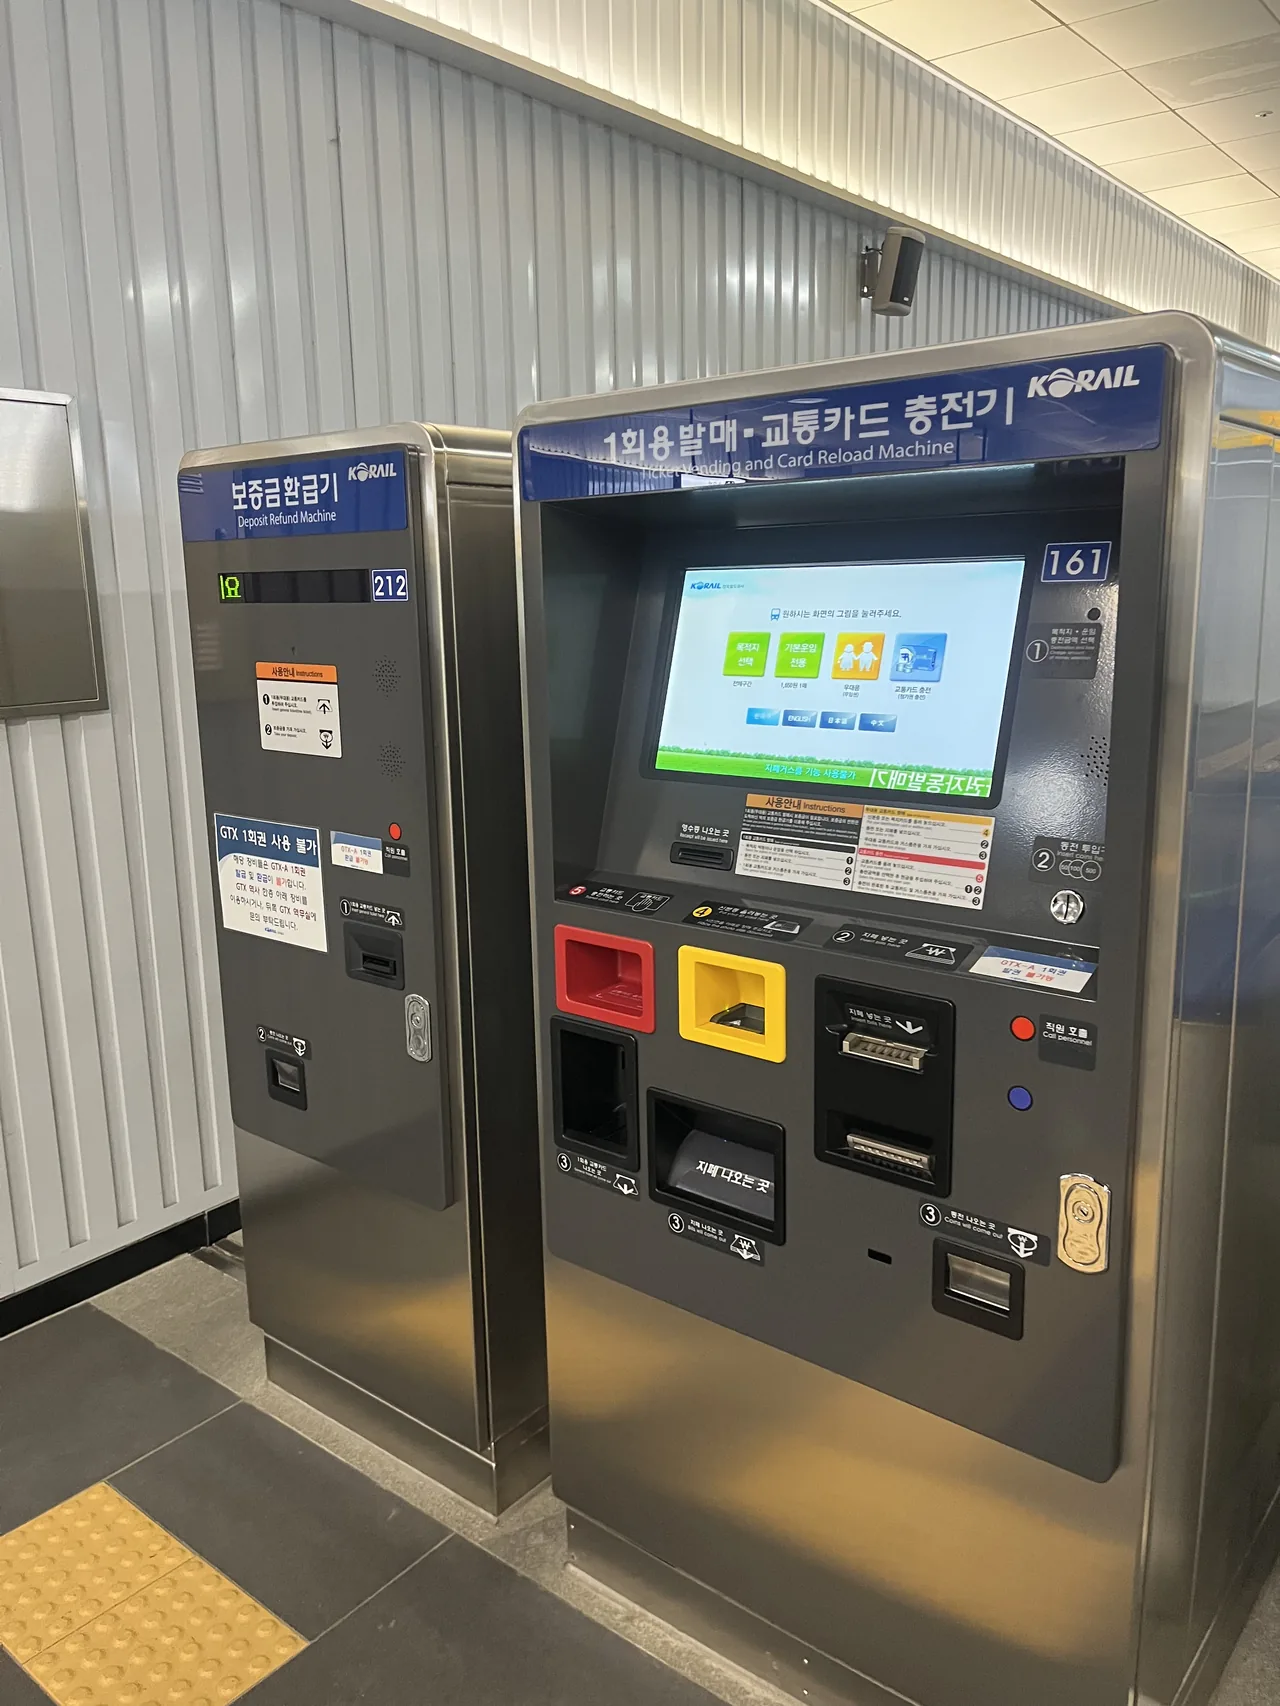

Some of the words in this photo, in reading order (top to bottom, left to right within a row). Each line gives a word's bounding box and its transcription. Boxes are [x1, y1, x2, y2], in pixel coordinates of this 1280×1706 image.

[1027, 364, 1140, 398] KORAIL
[904, 386, 1014, 436] 충전기
[682, 459, 741, 476] Vending
[744, 454, 773, 472] and
[777, 451, 813, 469] Card
[818, 446, 874, 465] Reload
[878, 440, 954, 460] Machine
[348, 462, 397, 482] KORAIL
[232, 472, 338, 511] 보증금환급기
[238, 515, 268, 530] Deposit
[270, 512, 298, 527] Refund
[300, 509, 336, 524] Machine
[1050, 548, 1101, 576] 161
[374, 575, 406, 597] 212
[690, 581, 721, 590] KORAIL
[782, 610, 811, 618] 원하시는
[812, 609, 834, 618] 화면의
[836, 609, 860, 618] 그림을
[861, 608, 902, 618] 눌러주세요.
[1082, 628, 1096, 636] 운임
[736, 642, 760, 652] 목적지
[1080, 636, 1095, 644] 선택
[784, 643, 817, 653] 기본운임
[738, 657, 754, 666] 선택
[790, 658, 807, 668] 전용
[272, 667, 295, 678] 사용안내
[296, 670, 323, 678] Instructions
[919, 686, 932, 694] 충전
[806, 767, 820, 778] 기능
[823, 768, 856, 780] 사용불가
[765, 796, 802, 810] 사용안내
[803, 803, 846, 813] Instructions
[702, 826, 721, 836] 나오는
[722, 829, 730, 837] 곳
[220, 825, 238, 840] GTX
[242, 829, 266, 847] 1회권
[271, 834, 291, 852] 사용
[296, 837, 317, 856] 불가
[1060, 841, 1078, 852] 동전
[236, 882, 247, 892] GTX
[279, 905, 291, 915] GTX
[694, 907, 711, 917] 4
[862, 932, 880, 940] 지폐
[880, 935, 897, 943] 넣는
[1000, 960, 1035, 971] GTX-A
[1042, 967, 1068, 976] 1회권
[849, 1008, 864, 1017] 지폐
[866, 1012, 882, 1022] 넣는
[883, 1016, 892, 1024] 곳
[1046, 1022, 1065, 1034] 직원
[1068, 1026, 1088, 1038] 호출
[1043, 1031, 1056, 1039] Call
[1058, 1034, 1092, 1046] personnel
[696, 1160, 718, 1178] 지폐
[720, 1168, 755, 1189] 나오는
[756, 1179, 771, 1194] 곳
[690, 1219, 701, 1228] 지폐
[701, 1223, 717, 1234] 나오는
[717, 1228, 724, 1237] 곳
[944, 1216, 961, 1226] Coins
[972, 1226, 991, 1236] come
[950, 1210, 964, 1221] 동전
[966, 1215, 987, 1228] 나오는
[988, 1222, 996, 1231] 곳
